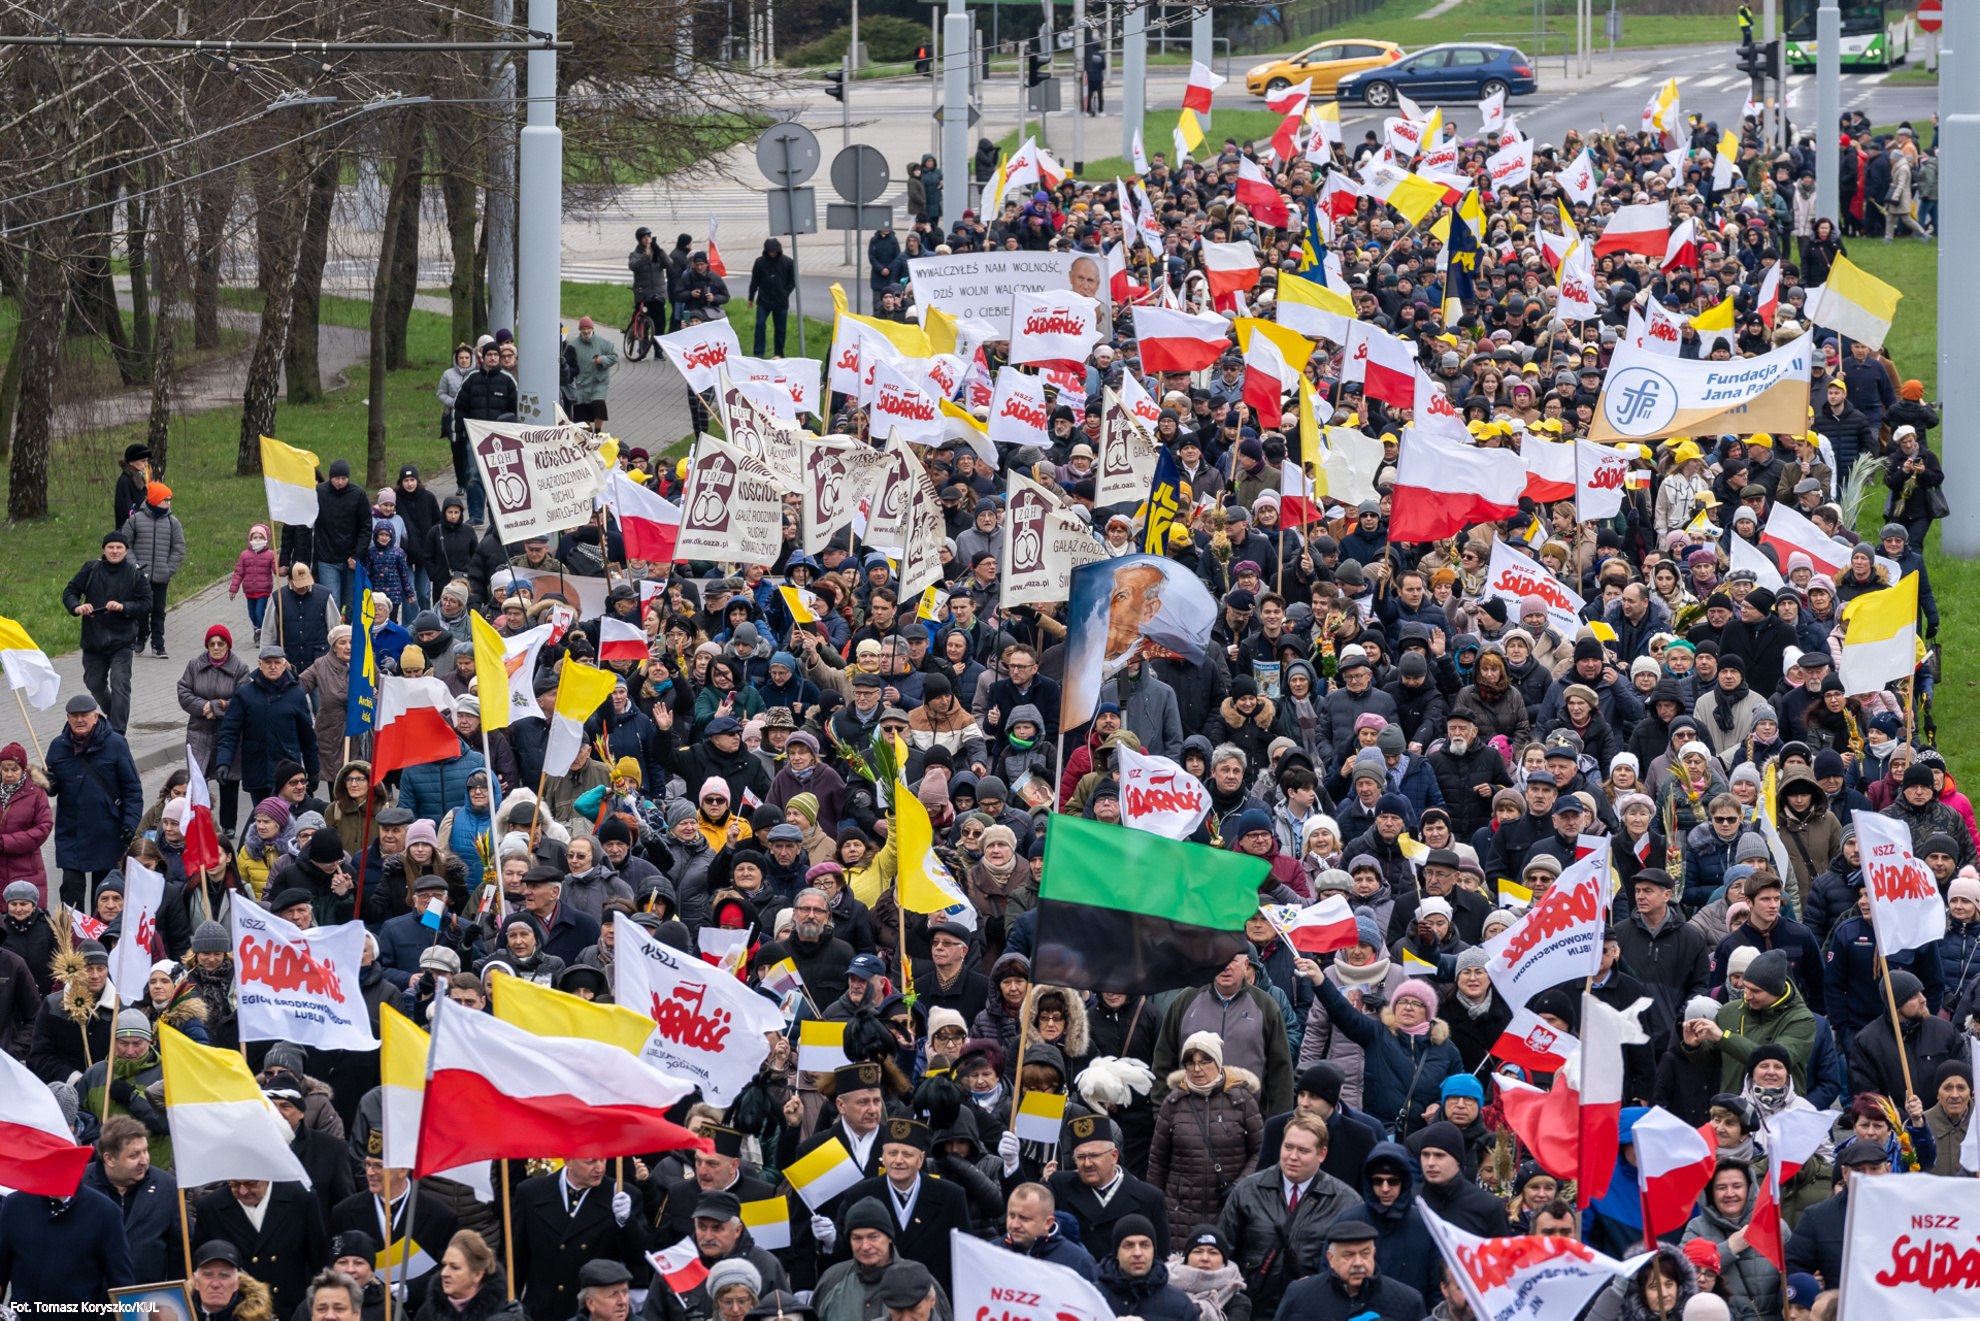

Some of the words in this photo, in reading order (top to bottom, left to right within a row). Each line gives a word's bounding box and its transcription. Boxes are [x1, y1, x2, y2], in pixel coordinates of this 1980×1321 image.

[916, 262, 979, 278] WYWALCZYŁEŚ
[985, 263, 1006, 273] NAM
[1013, 261, 1062, 275] WOLNOŚĆ,
[933, 286, 954, 299] DZIŚ
[959, 286, 988, 296] WOLNI
[964, 308, 972, 318] O
[979, 306, 1010, 317] CIEBIE
[1707, 364, 1777, 385] Fundacja
[883, 383, 900, 392] NSZZ
[1014, 391, 1034, 403] NSZZ
[1701, 388, 1742, 401] Jana
[1512, 564, 1537, 576] NSZZ
[1872, 844, 1896, 857] NSZZ
[641, 943, 680, 970] NSZZ
[1911, 1215, 1960, 1230] NSZZ
[991, 1287, 1041, 1307] NSZZ
